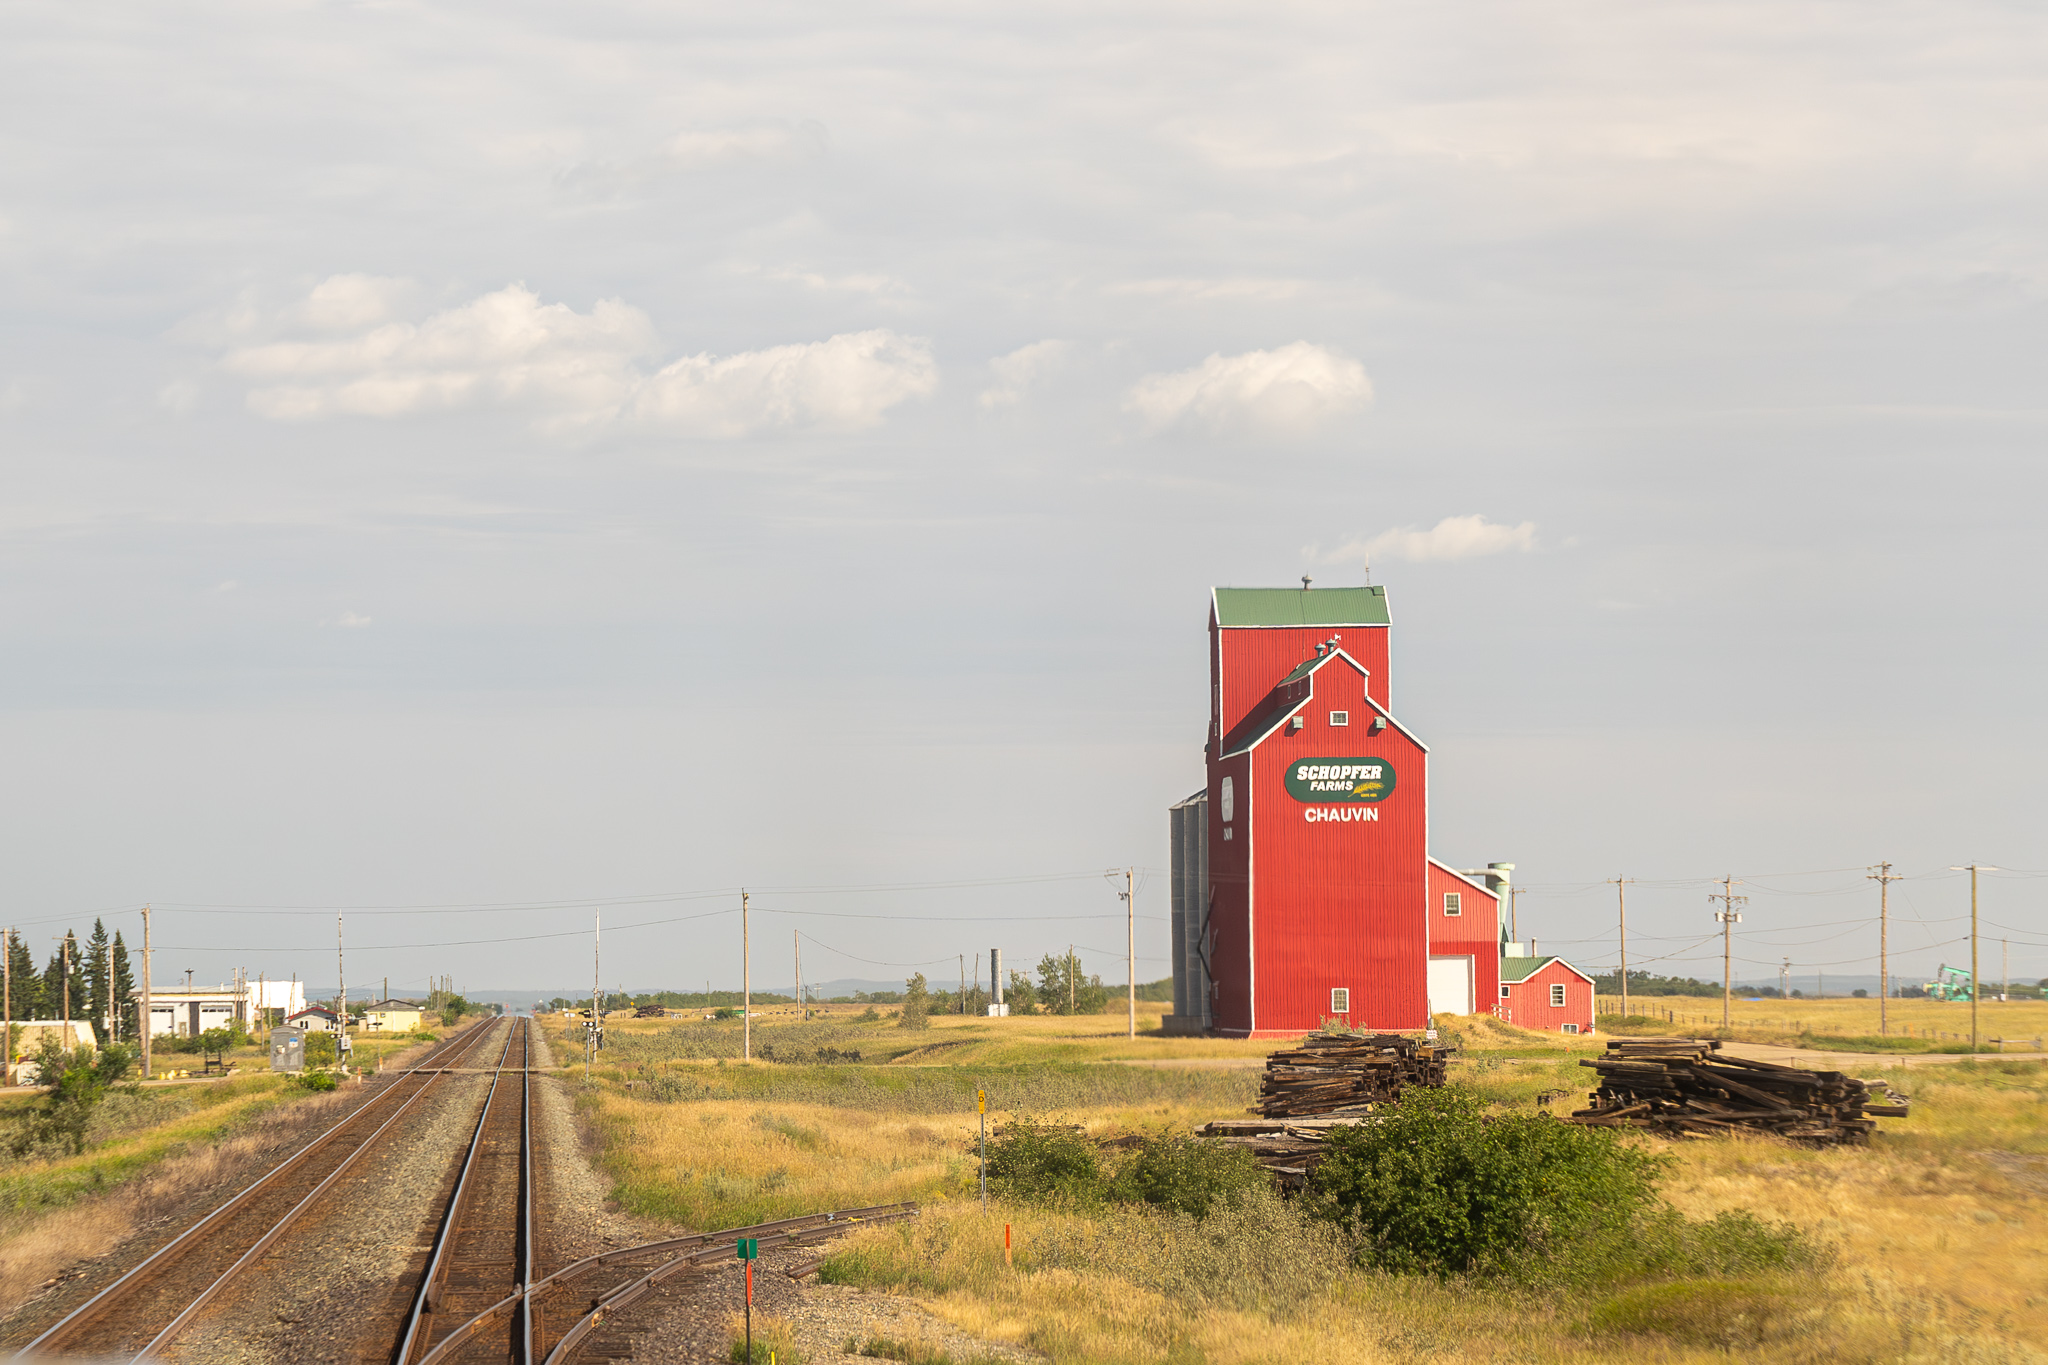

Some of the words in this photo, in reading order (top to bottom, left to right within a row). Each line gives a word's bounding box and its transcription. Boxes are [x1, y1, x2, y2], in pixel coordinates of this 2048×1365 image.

[1297, 765, 1382, 780] SCHOPFER
[1310, 781, 1354, 791] FARMS
[1304, 807, 1378, 822] CHAUVIN
